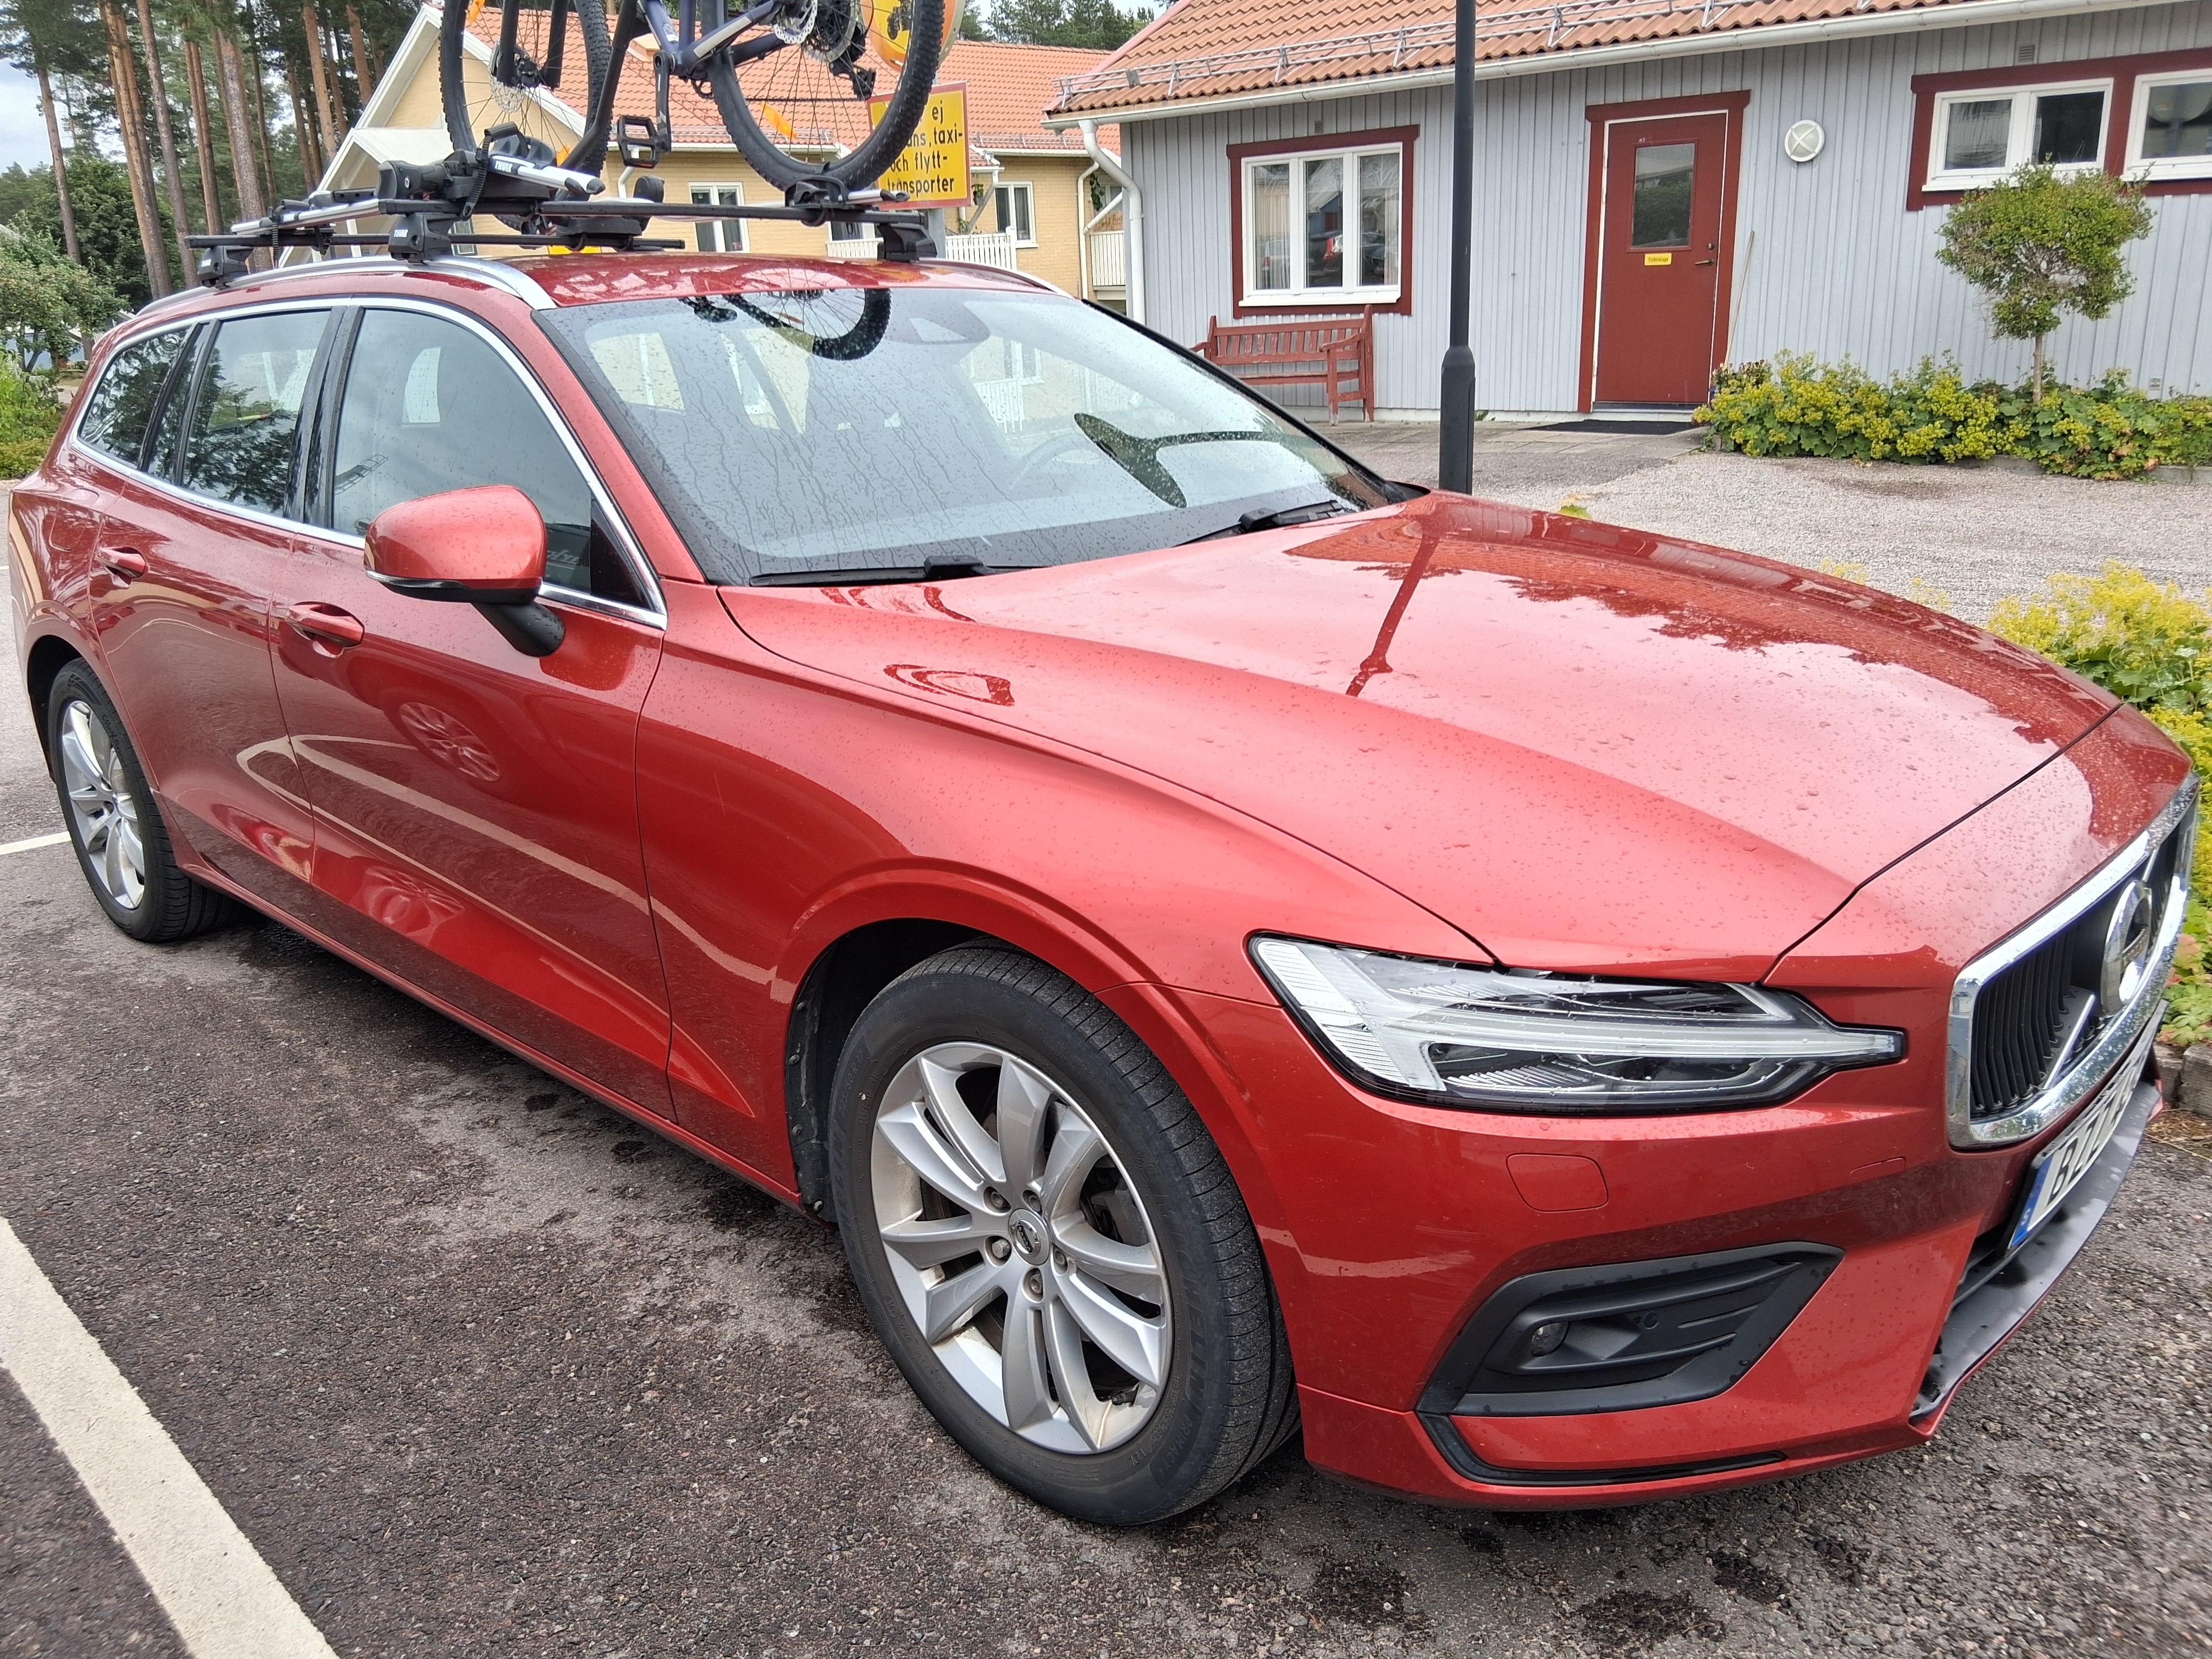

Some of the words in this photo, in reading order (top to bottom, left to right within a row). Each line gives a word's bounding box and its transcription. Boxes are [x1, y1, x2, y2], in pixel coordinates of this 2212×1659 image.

[932, 100, 943, 124] ej
[934, 123, 963, 145] taxi-
[494, 160, 513, 173] THULE
[890, 153, 909, 172] och
[915, 150, 948, 173] flytt-
[887, 174, 954, 198] transporter
[1153, 1194, 1207, 1400] MICHELIN
[1163, 1413, 1193, 1471] PRIMACY
